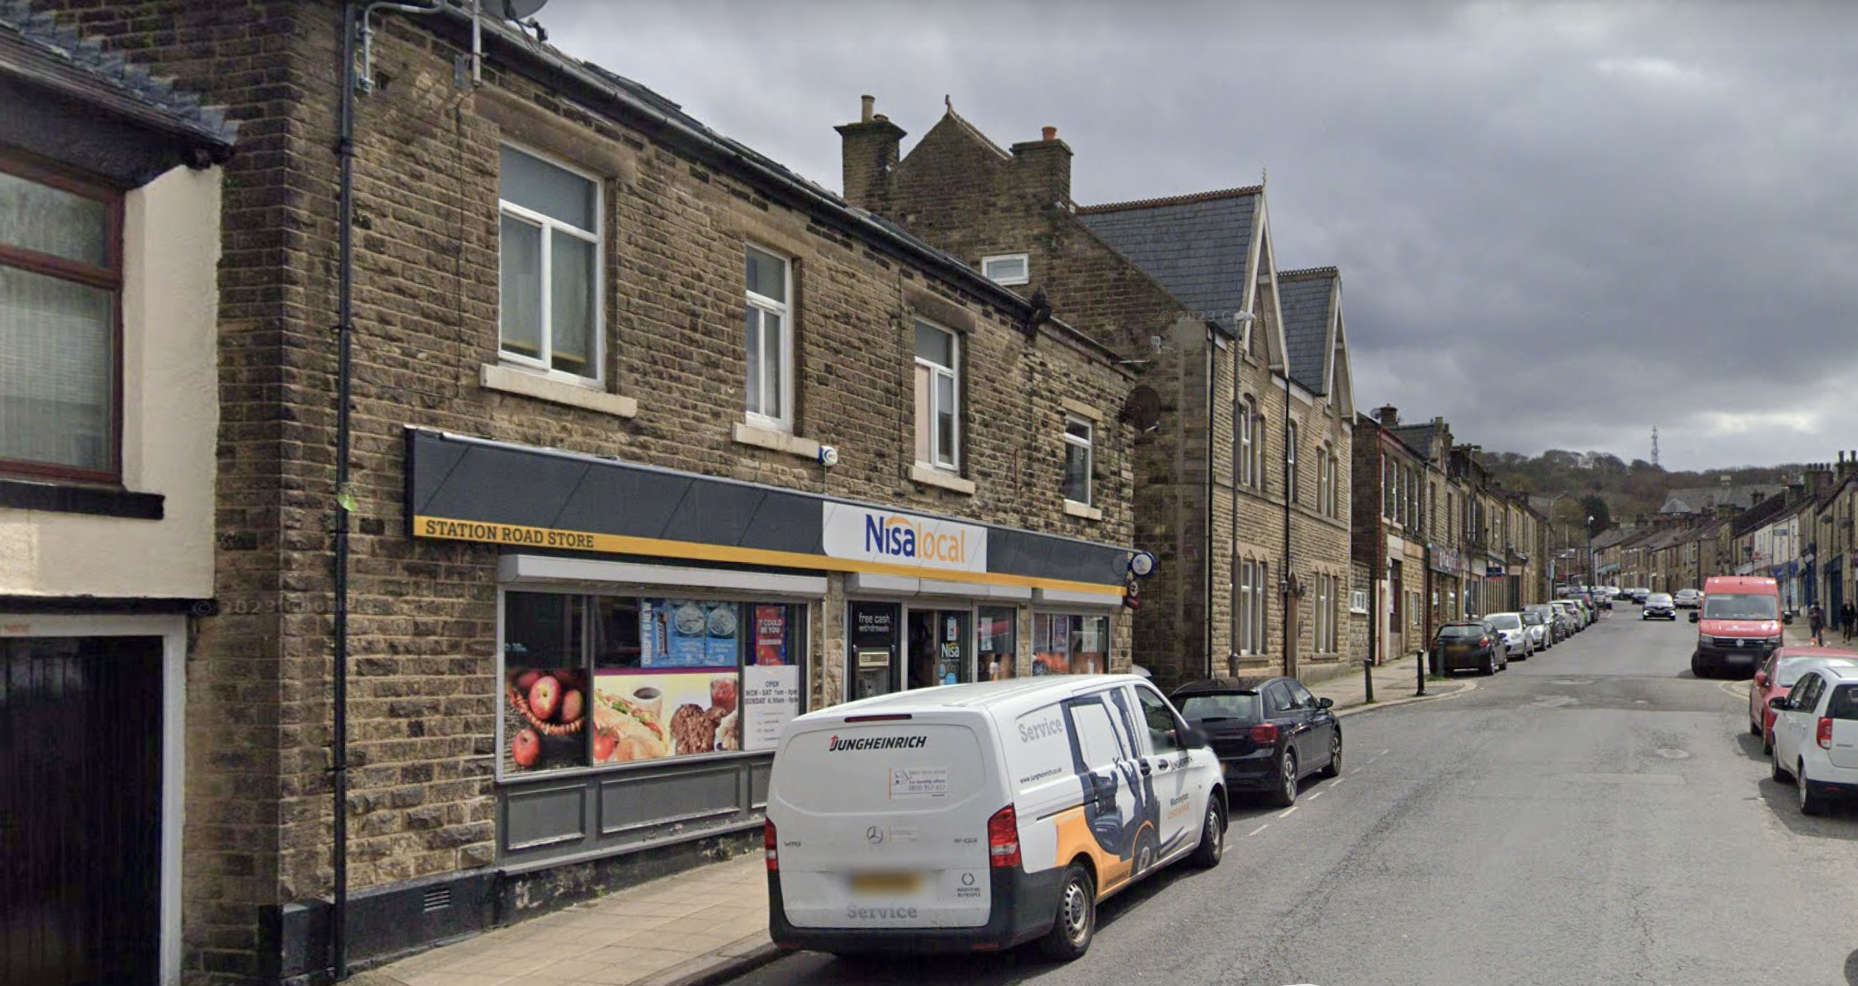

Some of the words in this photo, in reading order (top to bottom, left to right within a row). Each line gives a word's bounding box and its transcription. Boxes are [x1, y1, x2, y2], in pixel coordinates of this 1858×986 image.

[425, 519, 497, 541] STATION
[502, 527, 544, 545] ROAD
[548, 531, 595, 549] STORE
[859, 611, 873, 624] free
[874, 612, 890, 625] cash
[941, 642, 960, 658] Nisa
[1018, 717, 1063, 743] Service
[829, 735, 928, 752] JUNGHEINRICH
[846, 902, 919, 920] Service
